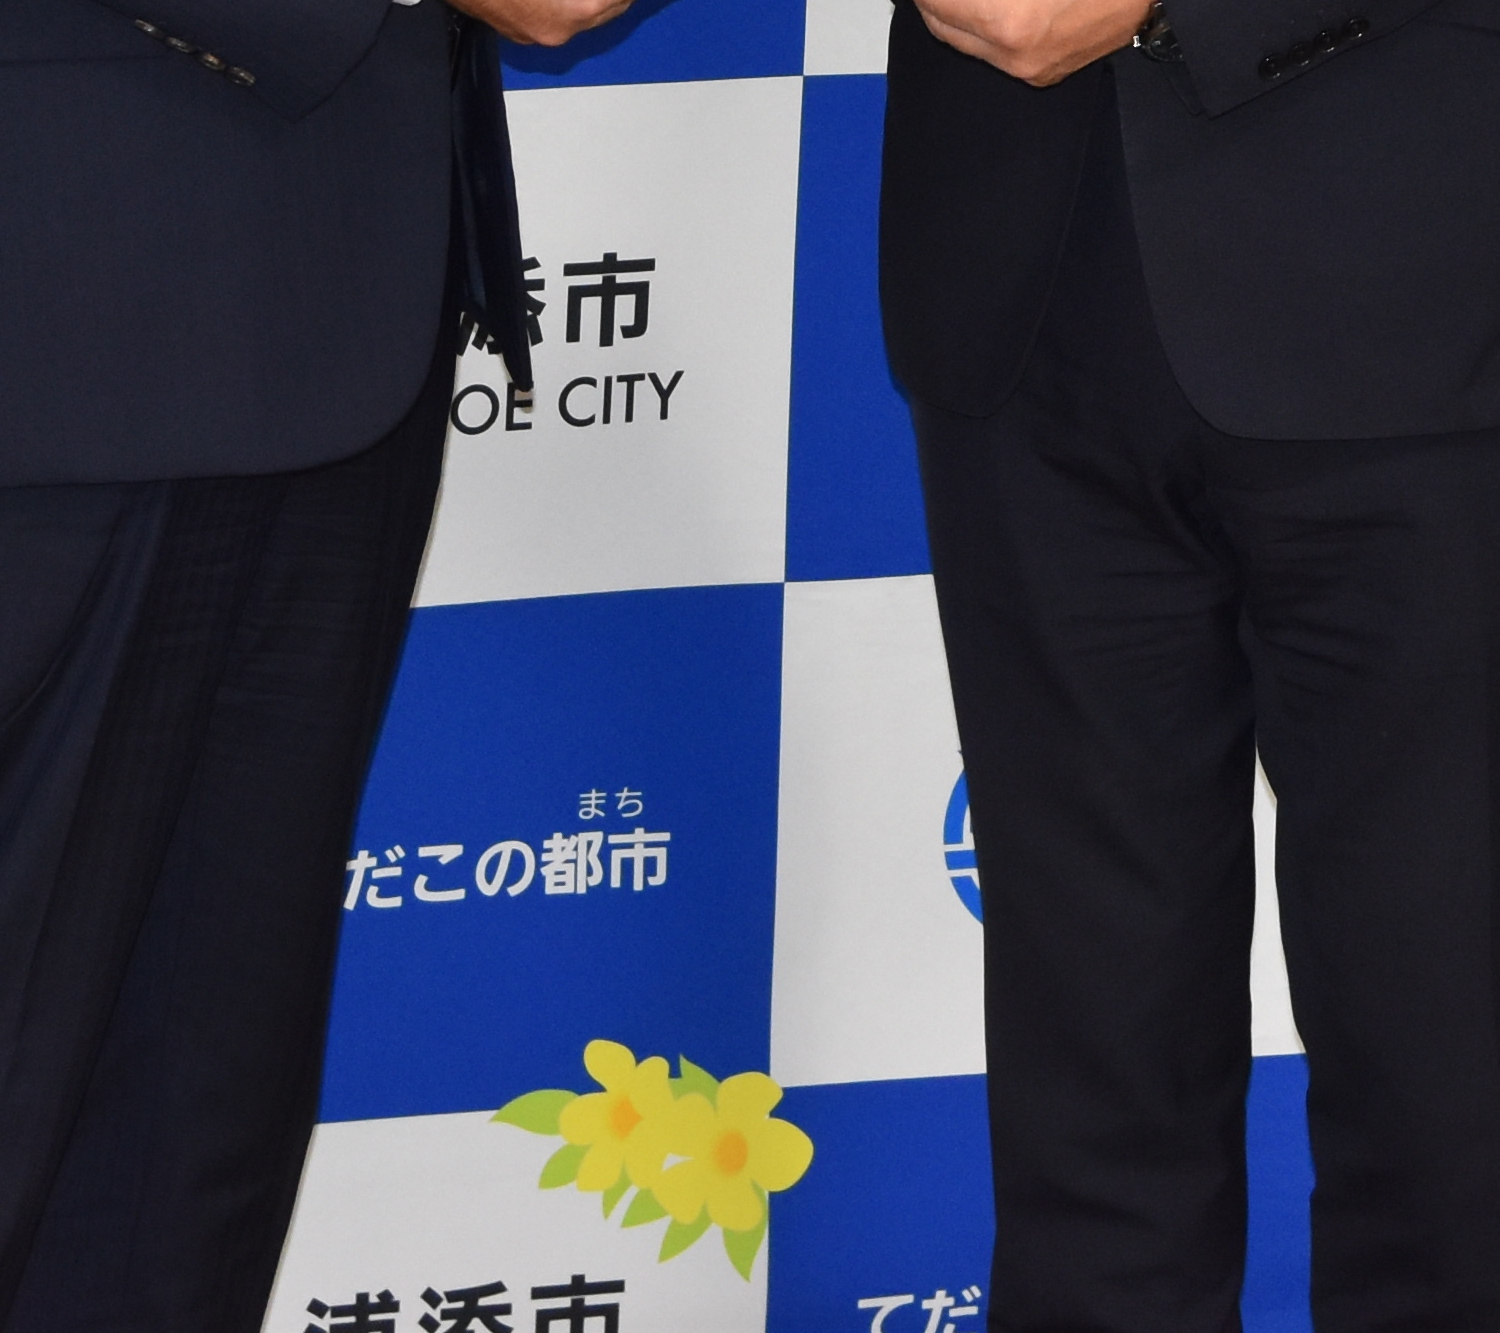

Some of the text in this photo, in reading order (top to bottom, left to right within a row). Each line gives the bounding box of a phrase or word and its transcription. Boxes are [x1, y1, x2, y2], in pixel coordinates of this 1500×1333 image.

[559, 371, 684, 427] CITY
[578, 787, 643, 819] まち
[344, 828, 670, 911] だこの都市
